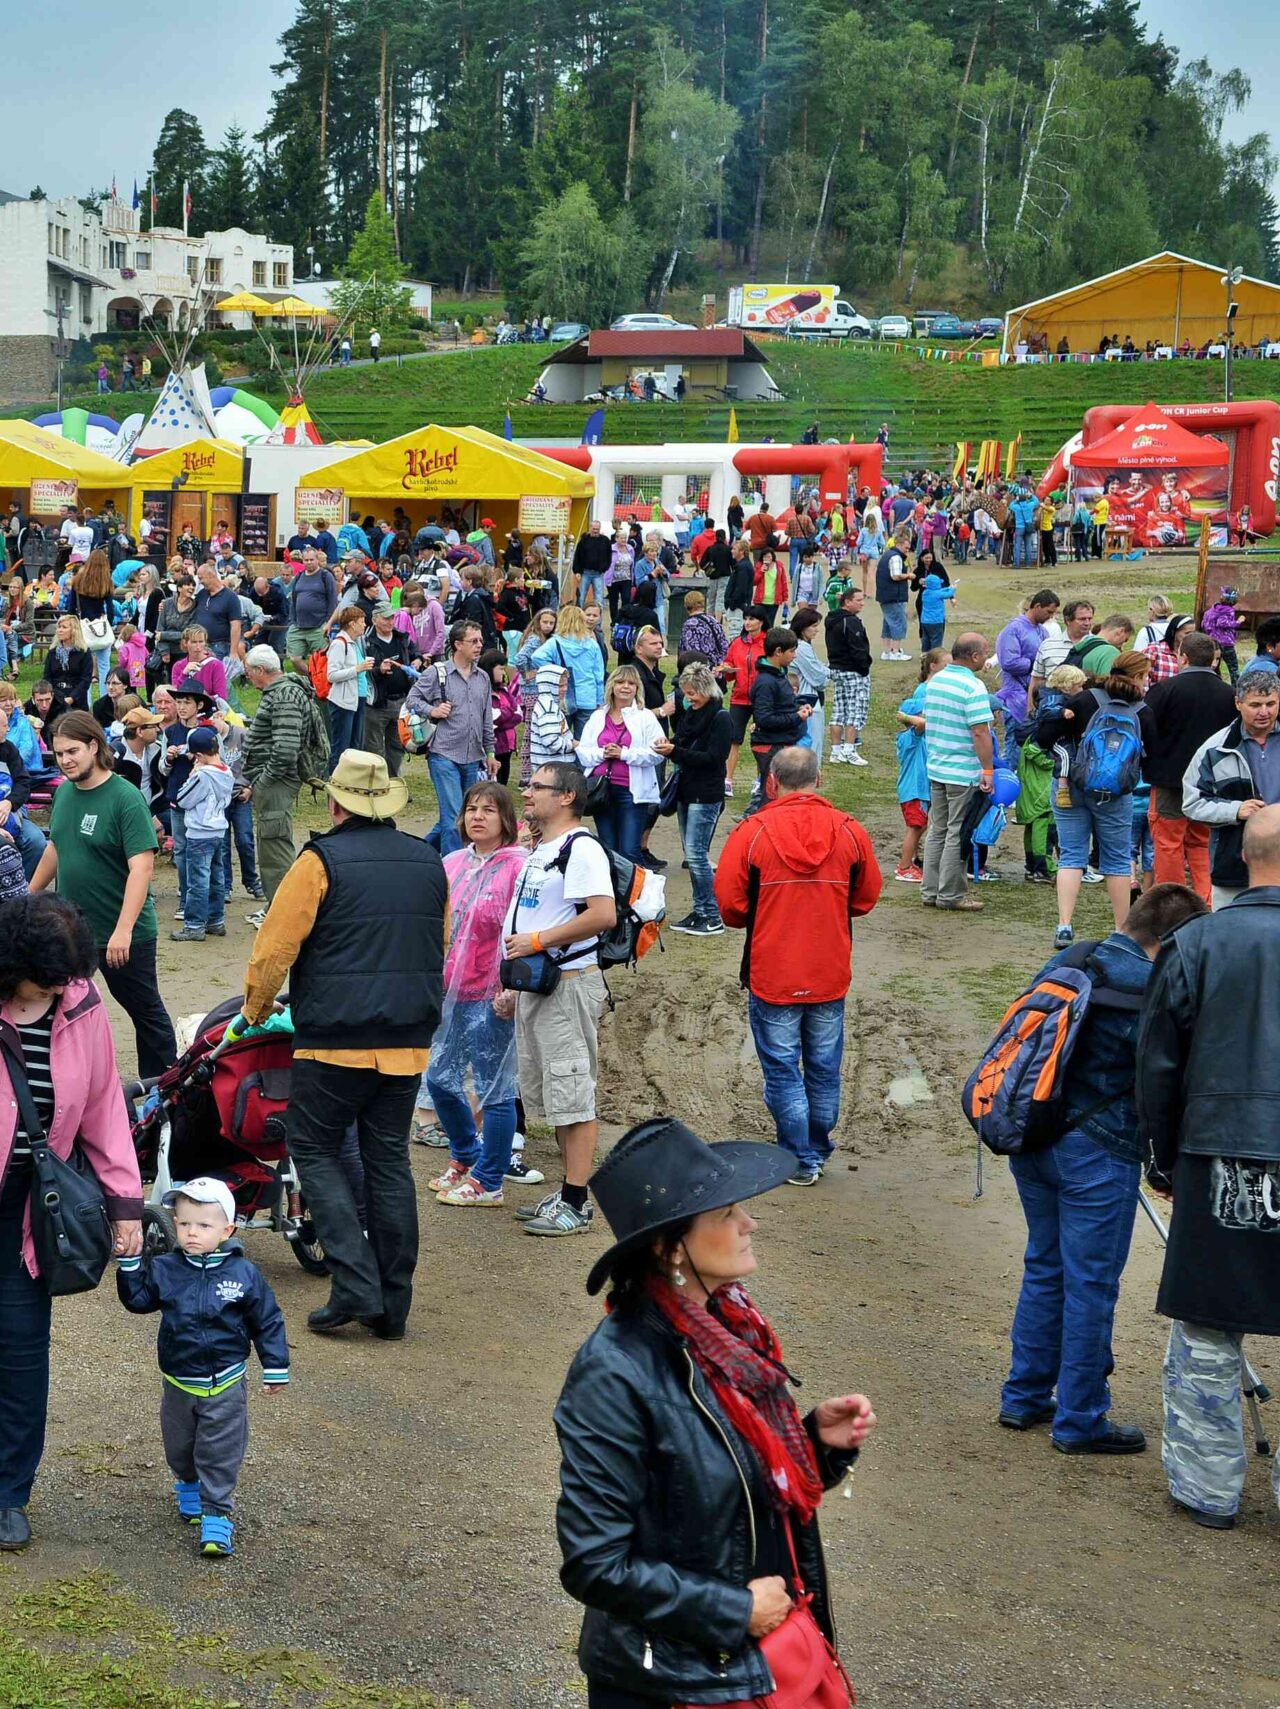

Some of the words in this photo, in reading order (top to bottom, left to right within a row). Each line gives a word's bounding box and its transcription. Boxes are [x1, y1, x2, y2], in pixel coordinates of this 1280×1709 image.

[1186, 407, 1211, 416] Junior
[1212, 406, 1229, 416] Cup
[182, 451, 216, 471] Rebel
[402, 446, 458, 480] Rebel
